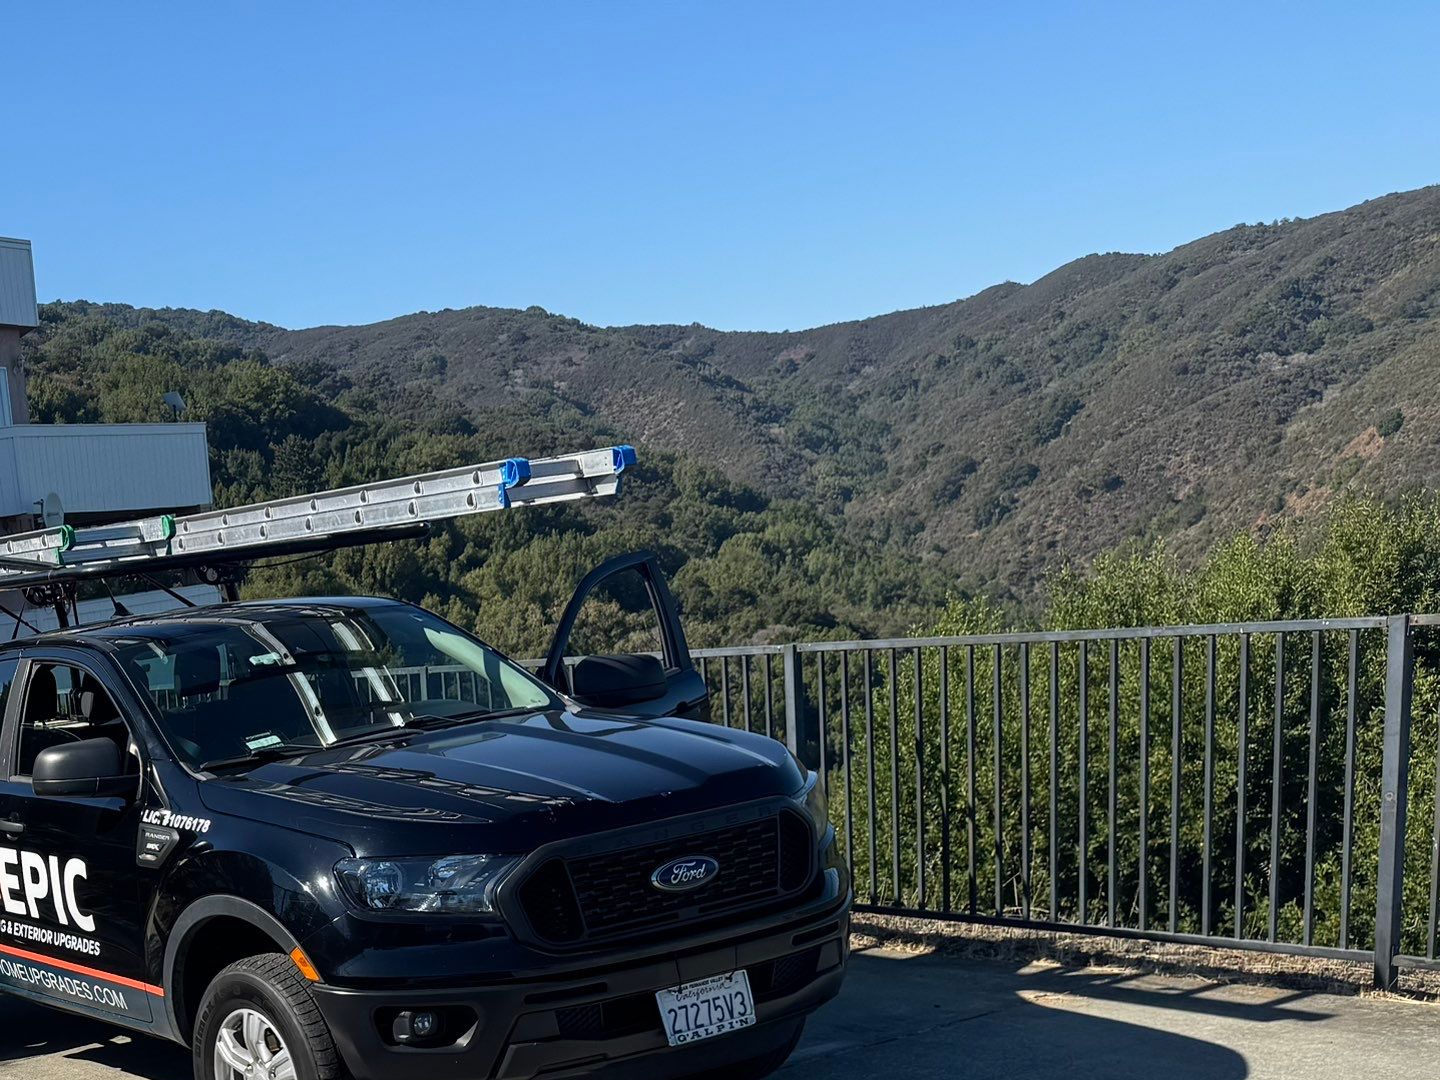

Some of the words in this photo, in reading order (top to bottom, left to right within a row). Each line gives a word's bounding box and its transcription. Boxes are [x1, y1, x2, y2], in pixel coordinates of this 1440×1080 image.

[671, 861, 706, 884] Ford
[6, 922, 13, 935] &
[13, 923, 53, 946] EXTERIOR
[53, 931, 101, 956] UPGRADES
[676, 982, 731, 1001] California
[667, 991, 747, 1034] 27275V3
